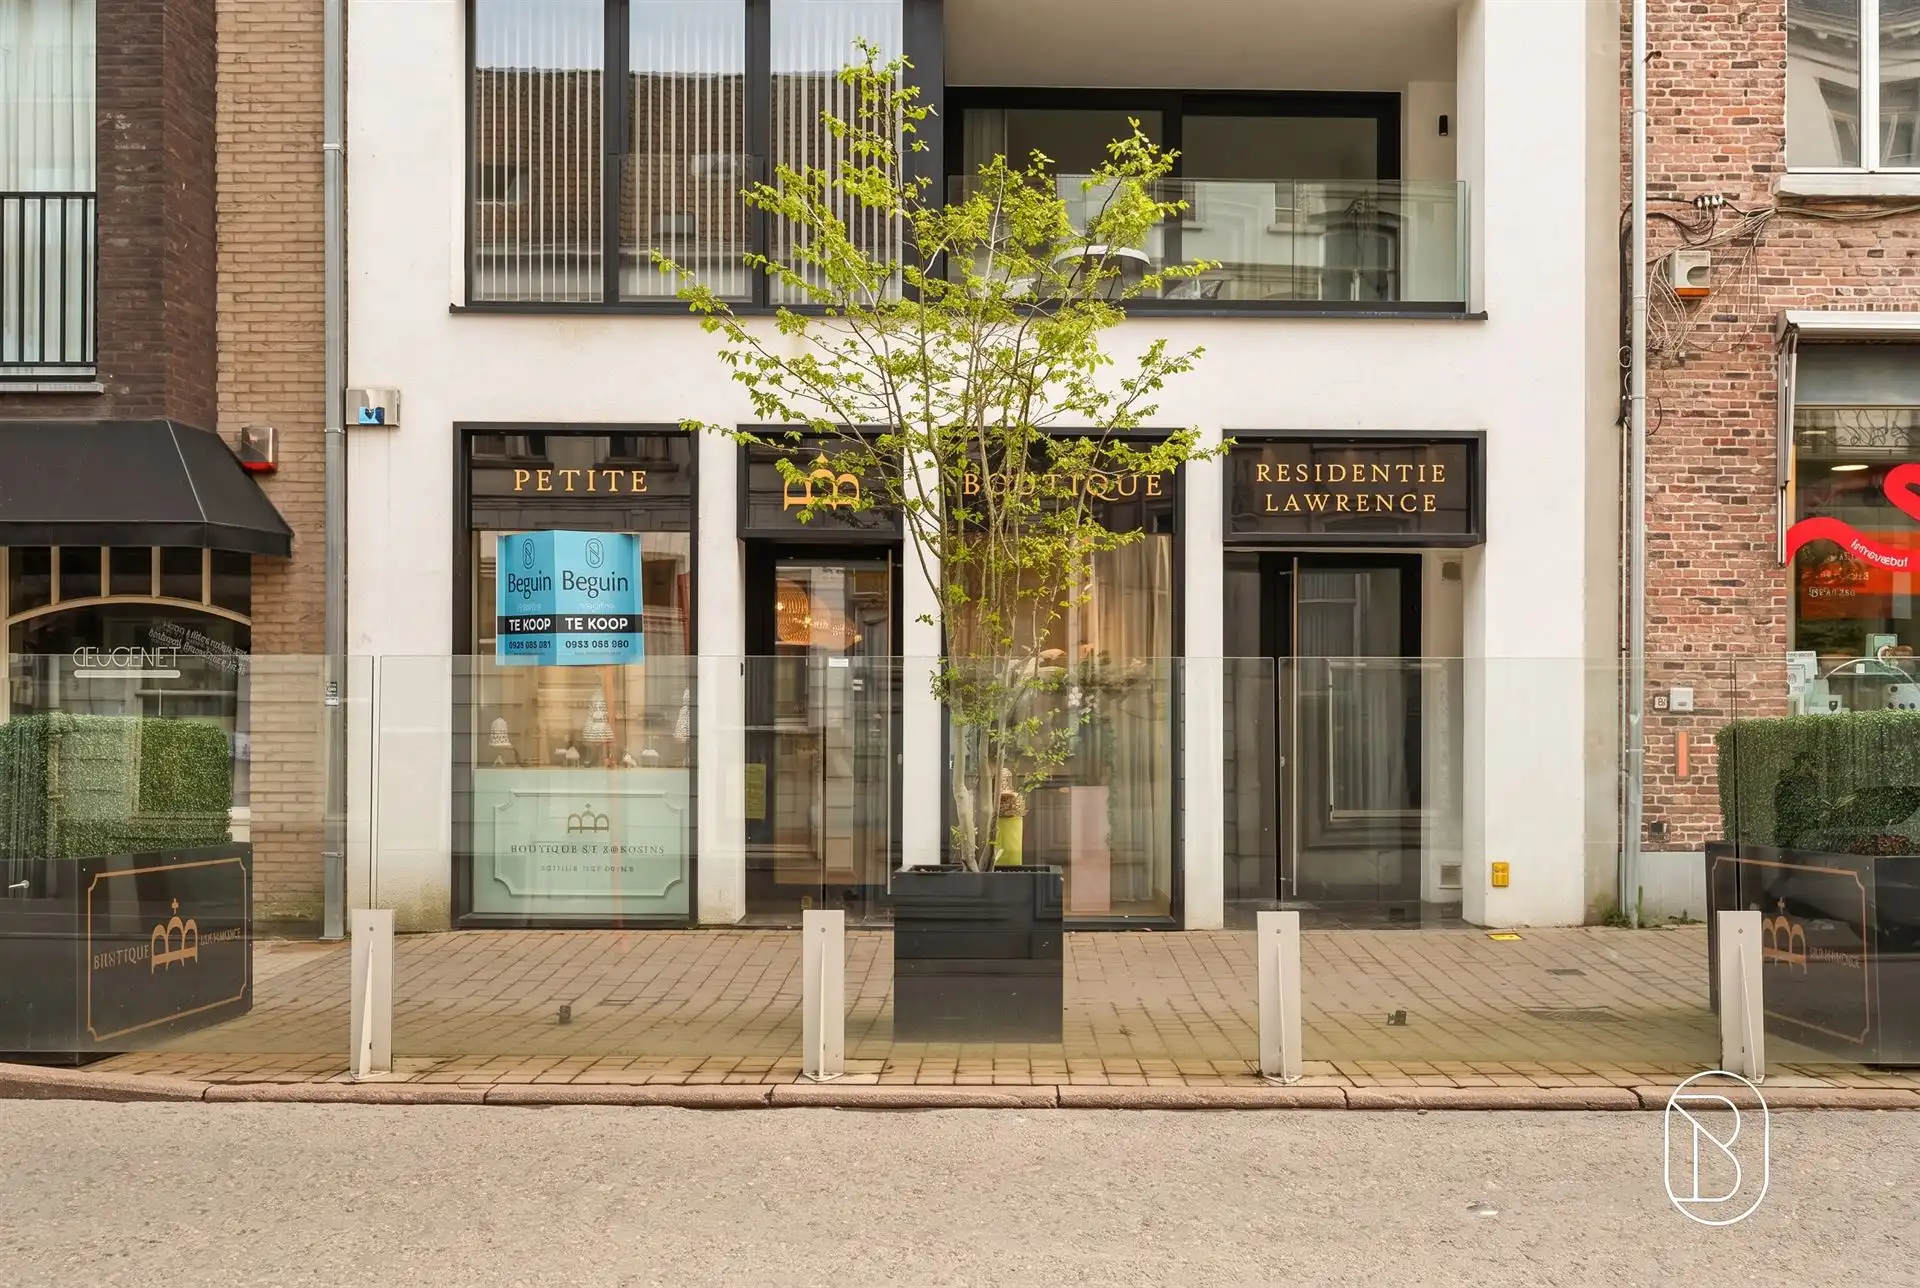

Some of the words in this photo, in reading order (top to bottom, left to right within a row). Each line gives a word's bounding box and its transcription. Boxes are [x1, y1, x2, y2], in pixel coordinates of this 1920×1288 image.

[514, 469, 647, 492] PETITE
[1256, 464, 1446, 482] RESIDENTIE
[1265, 494, 1437, 512] LAWRENCE
[508, 571, 552, 599] Beguin
[562, 570, 628, 598] Beguin
[509, 619, 520, 631] TE
[522, 618, 551, 631] KOOP
[565, 618, 583, 630] TE
[587, 618, 628, 630] KOOP
